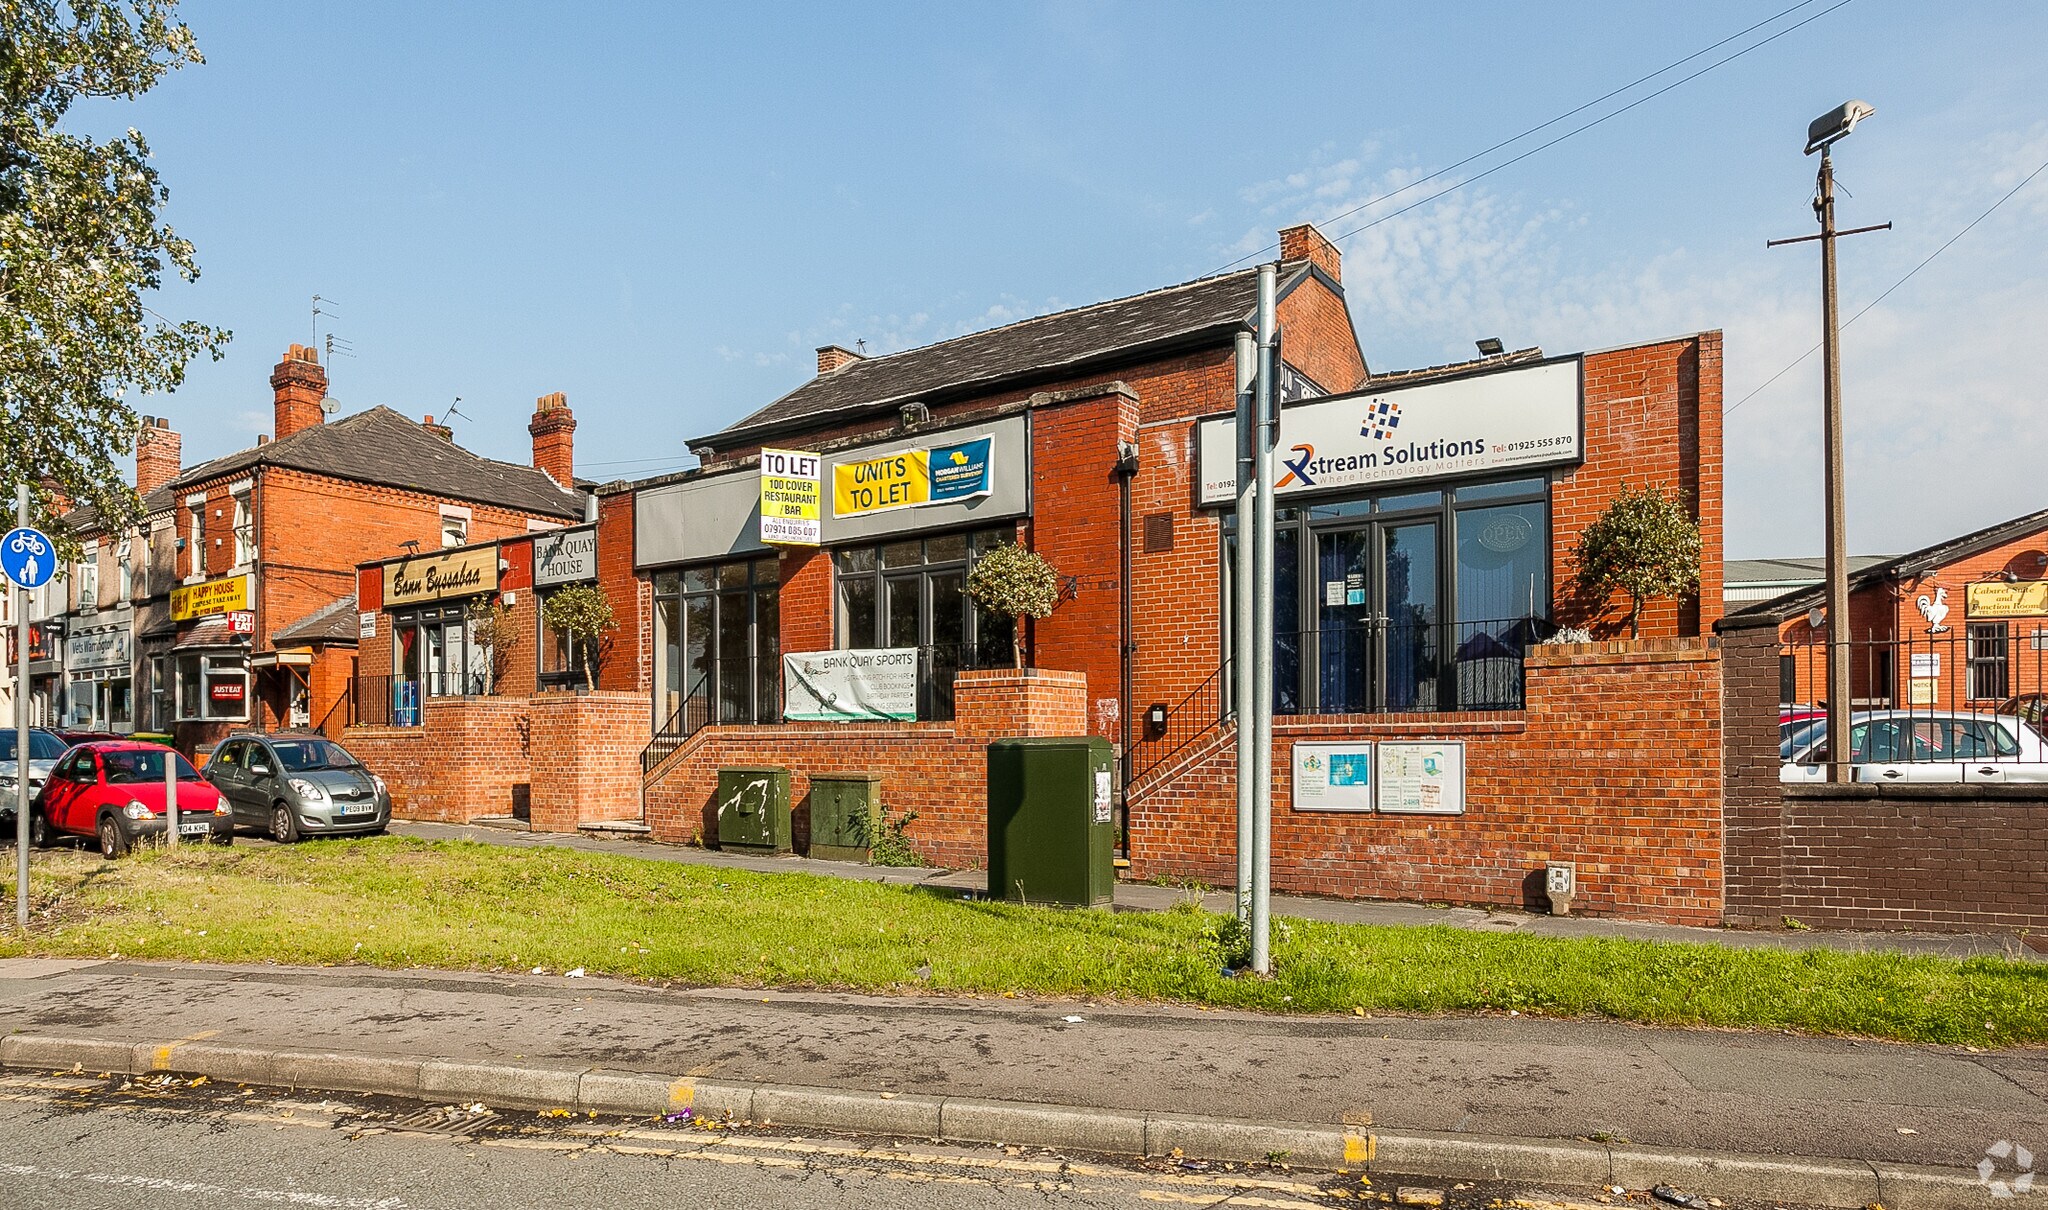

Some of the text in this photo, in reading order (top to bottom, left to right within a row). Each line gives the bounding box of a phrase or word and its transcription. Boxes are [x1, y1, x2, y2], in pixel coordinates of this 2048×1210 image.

[1492, 435, 1572, 453] Tel: 01925 555 870
[1383, 438, 1485, 466] Solutions
[765, 453, 818, 476] TO LET
[855, 457, 906, 484] UNITS
[1319, 457, 1485, 484] Where Technology Matters
[769, 479, 813, 492] 100 COVER
[764, 490, 817, 505] RESTAURANT
[850, 487, 873, 509] TO
[879, 481, 911, 505] LET
[764, 523, 786, 534] 07974
[536, 538, 595, 559] BANK QUAY
[547, 559, 584, 577] HOUSE
[192, 581, 235, 600] HAPPY HOUSE
[1974, 586, 2035, 595] Cabaret Suite
[1996, 594, 2014, 602] and
[1972, 602, 2011, 610] Function
[229, 612, 253, 623] JUST
[234, 622, 253, 632] EAT
[72, 639, 114, 654] Vets Warrington
[823, 653, 913, 669] BANK QUAY SPORTS
[883, 682, 910, 690] BOOKINGS
[193, 823, 208, 832] KHL
